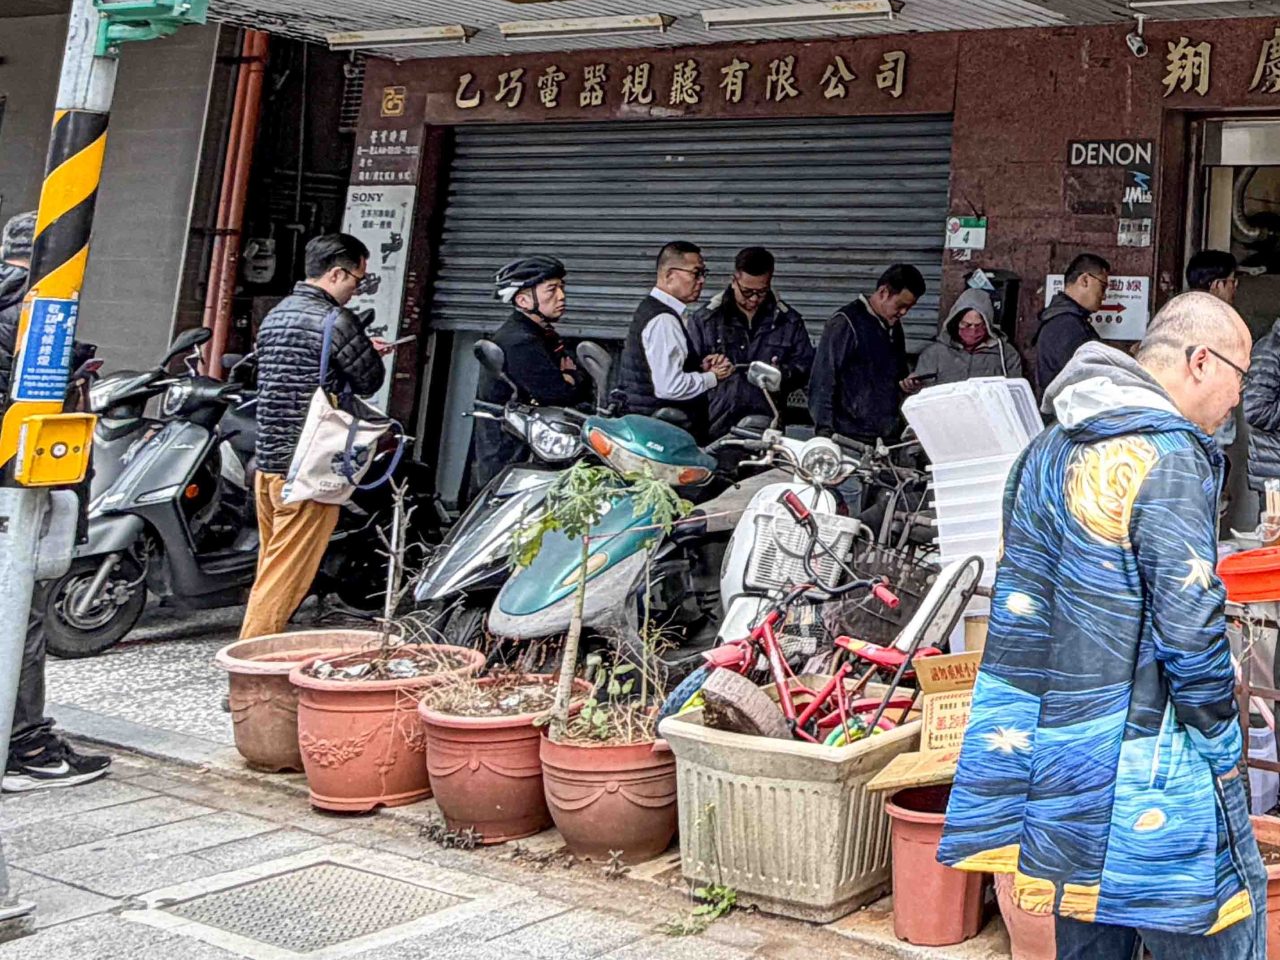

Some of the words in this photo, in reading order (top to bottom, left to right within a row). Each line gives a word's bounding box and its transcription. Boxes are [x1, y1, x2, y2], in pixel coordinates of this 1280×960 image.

[455, 50, 908, 110] 乙巧電器視聽有限公司
[1070, 143, 1152, 165] DENON
[352, 193, 384, 203] SONY
